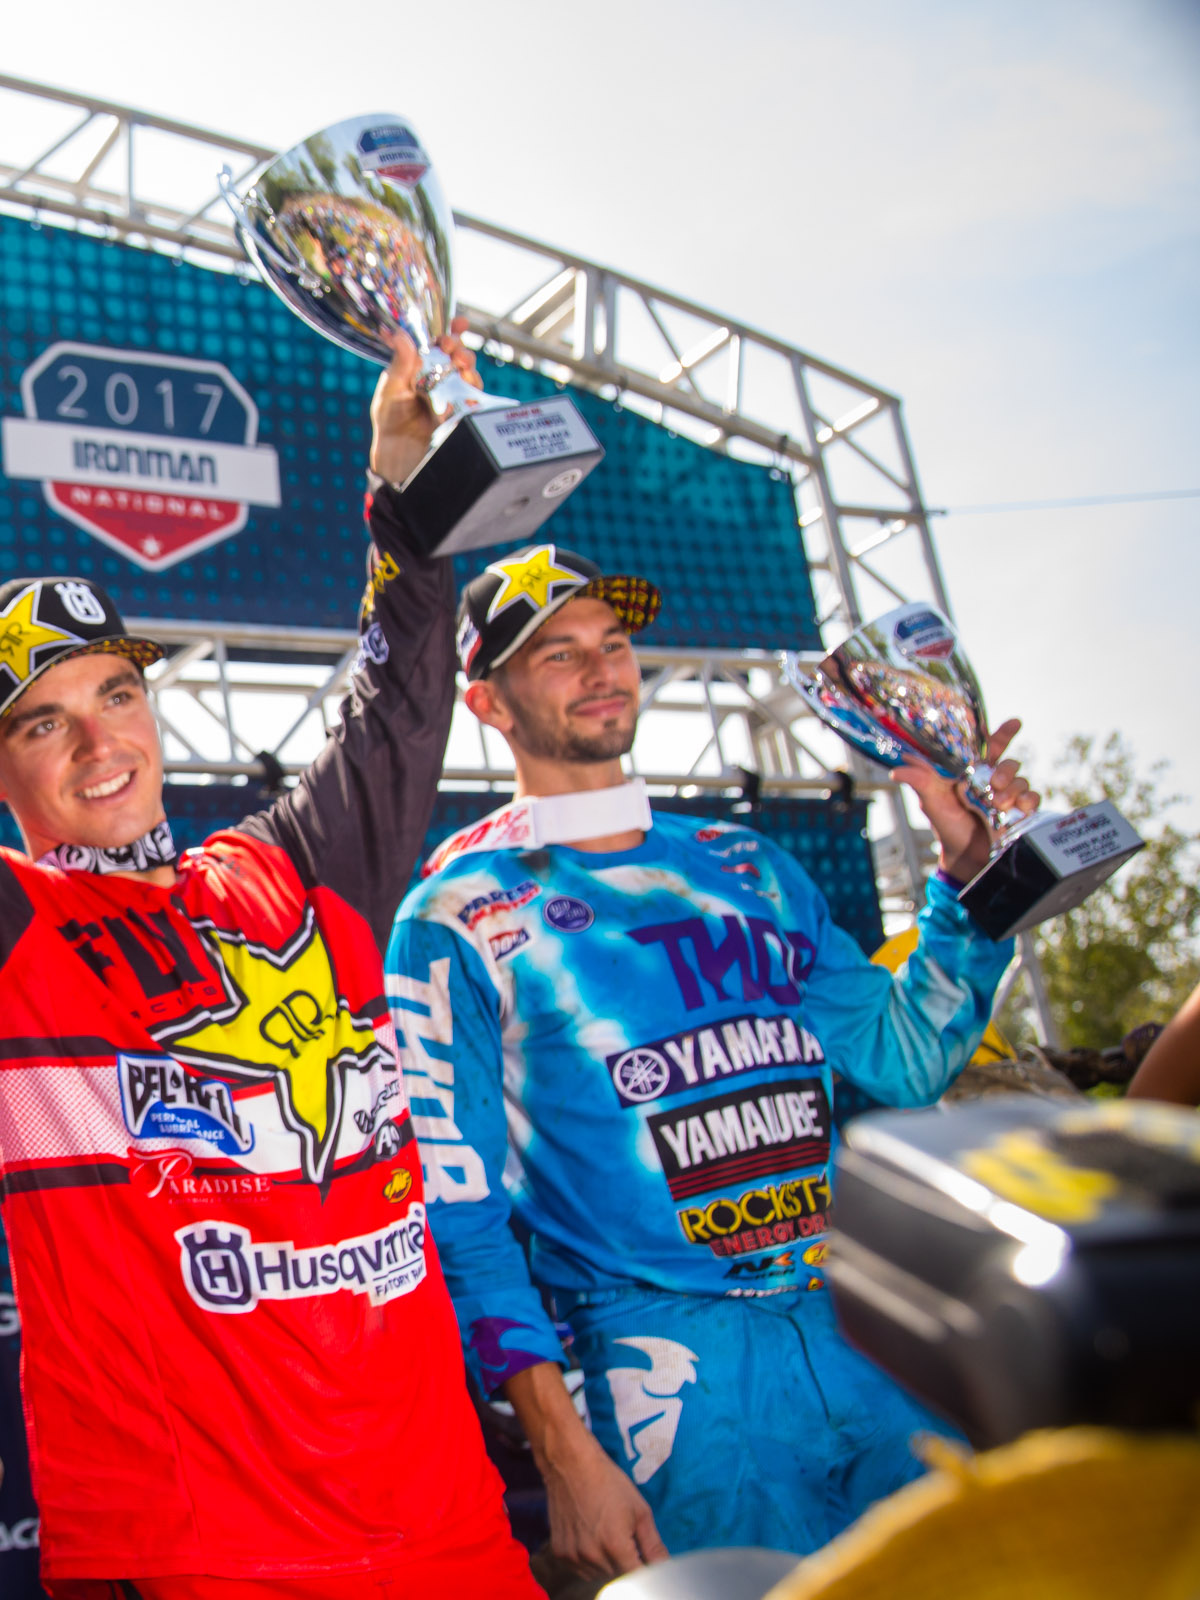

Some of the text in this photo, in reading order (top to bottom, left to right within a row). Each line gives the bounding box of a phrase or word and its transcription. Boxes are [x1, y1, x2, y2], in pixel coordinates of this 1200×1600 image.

[56, 364, 224, 435] 2017
[72, 438, 218, 486] IRONMAN
[70, 486, 225, 522] NATIONAL
[132, 1152, 271, 1199] PARADISE
[680, 1172, 832, 1243] ROCKST
[254, 1220, 425, 1292] Husqvrna
[708, 1219, 795, 1257] ENERGY
[797, 1212, 832, 1238] DRI
